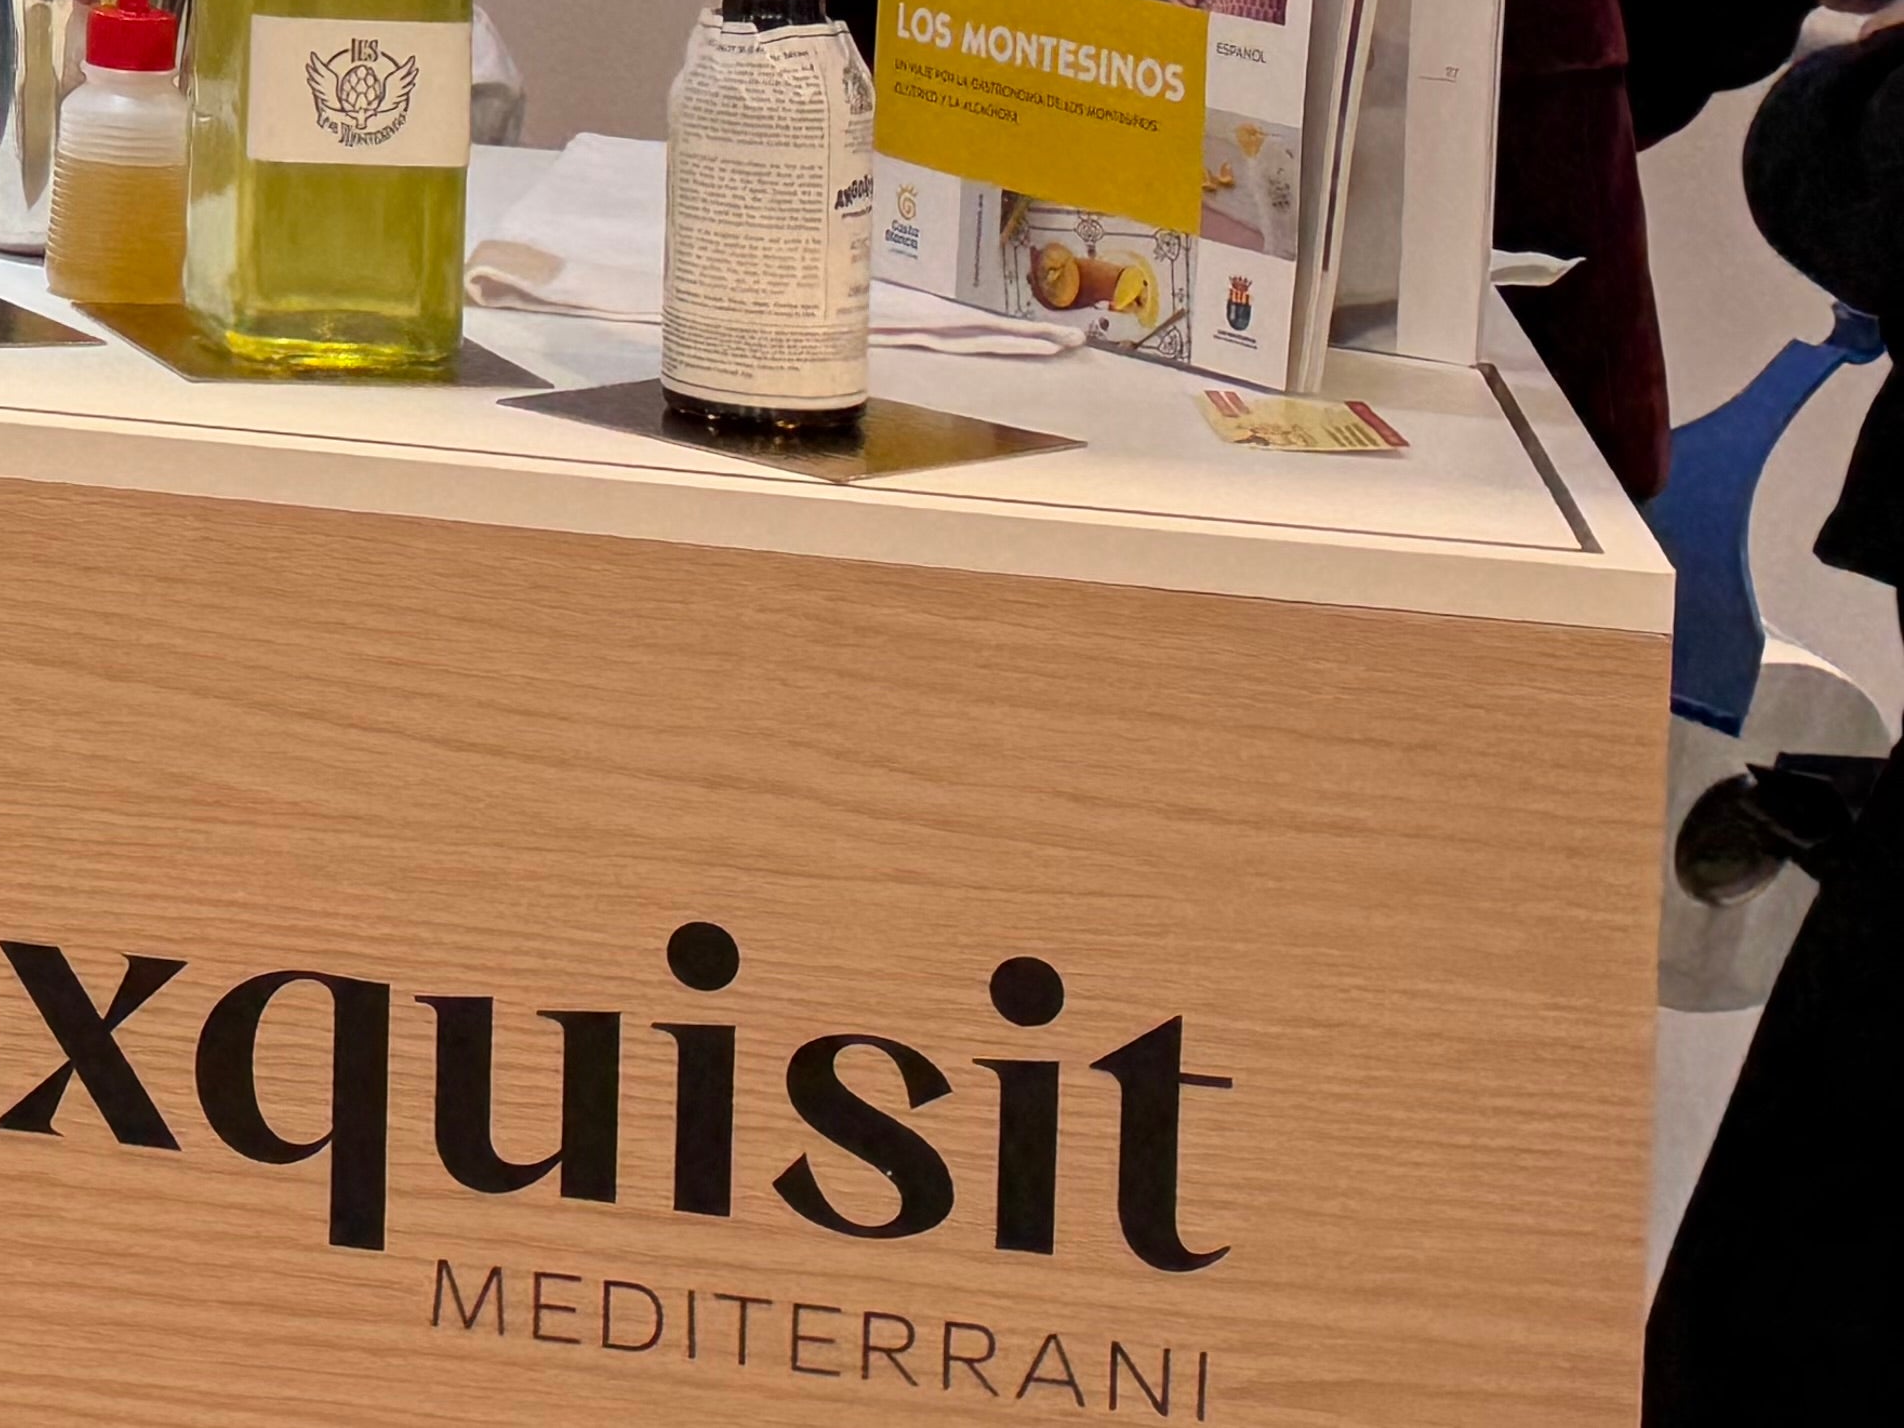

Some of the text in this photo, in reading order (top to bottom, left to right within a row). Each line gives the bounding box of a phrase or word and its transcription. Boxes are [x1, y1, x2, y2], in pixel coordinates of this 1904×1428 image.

[897, 2, 1186, 102] LOS MONTESINOS
[429, 1257, 1210, 1423] MEDITERRANI
